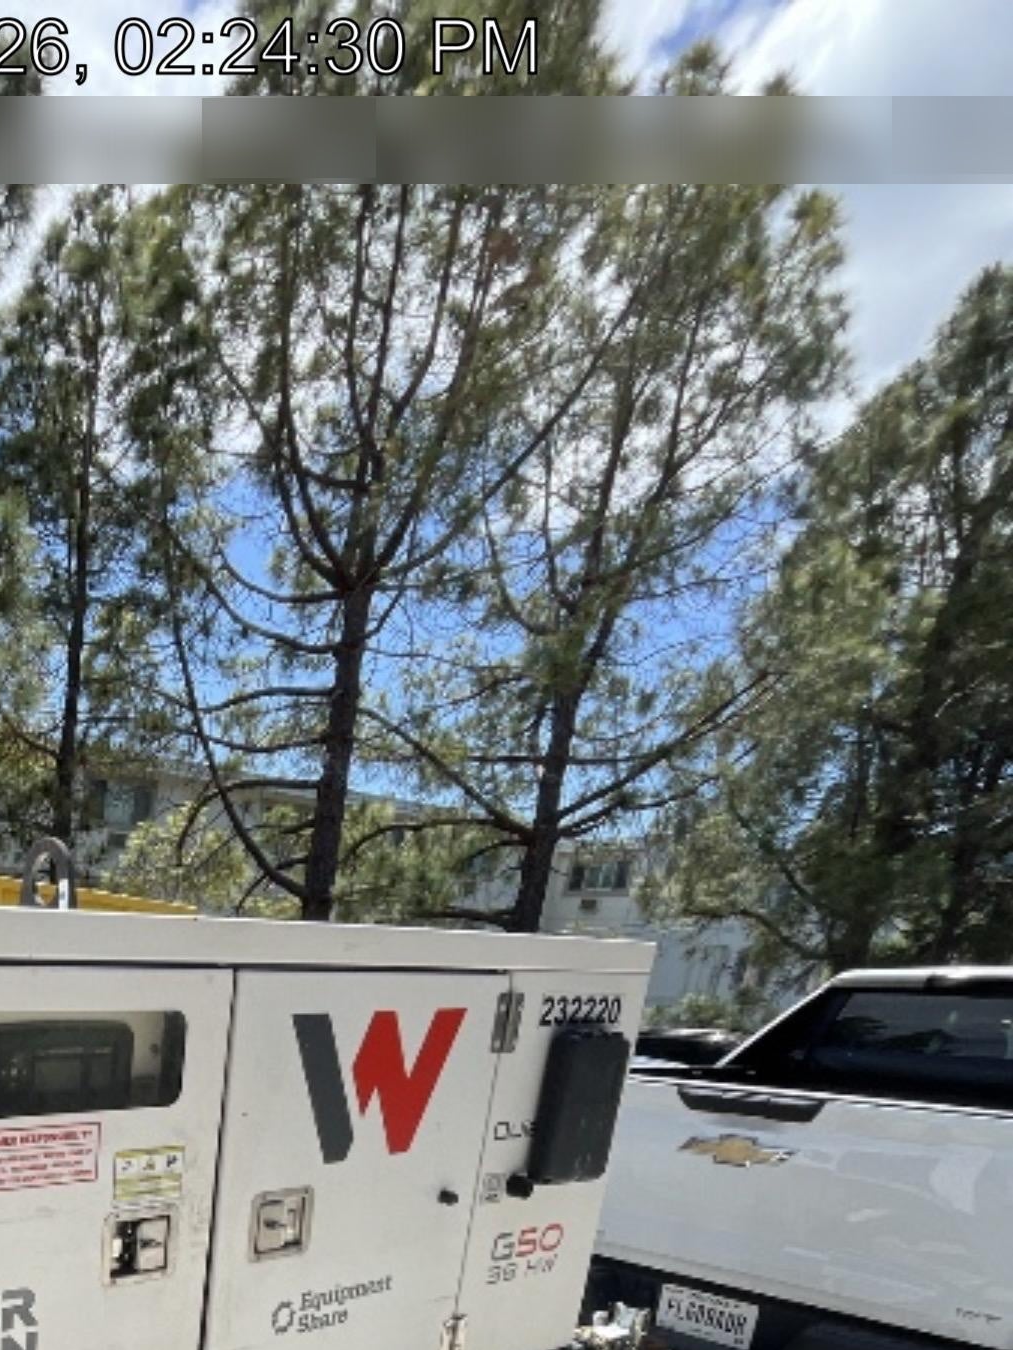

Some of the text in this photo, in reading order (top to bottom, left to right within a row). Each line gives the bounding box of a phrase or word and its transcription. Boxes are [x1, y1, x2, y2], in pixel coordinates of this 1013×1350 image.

[539, 995, 621, 1026] 232220
[490, 1223, 565, 1262] G50
[299, 1274, 393, 1311] Equipment
[296, 1308, 349, 1333] Share
